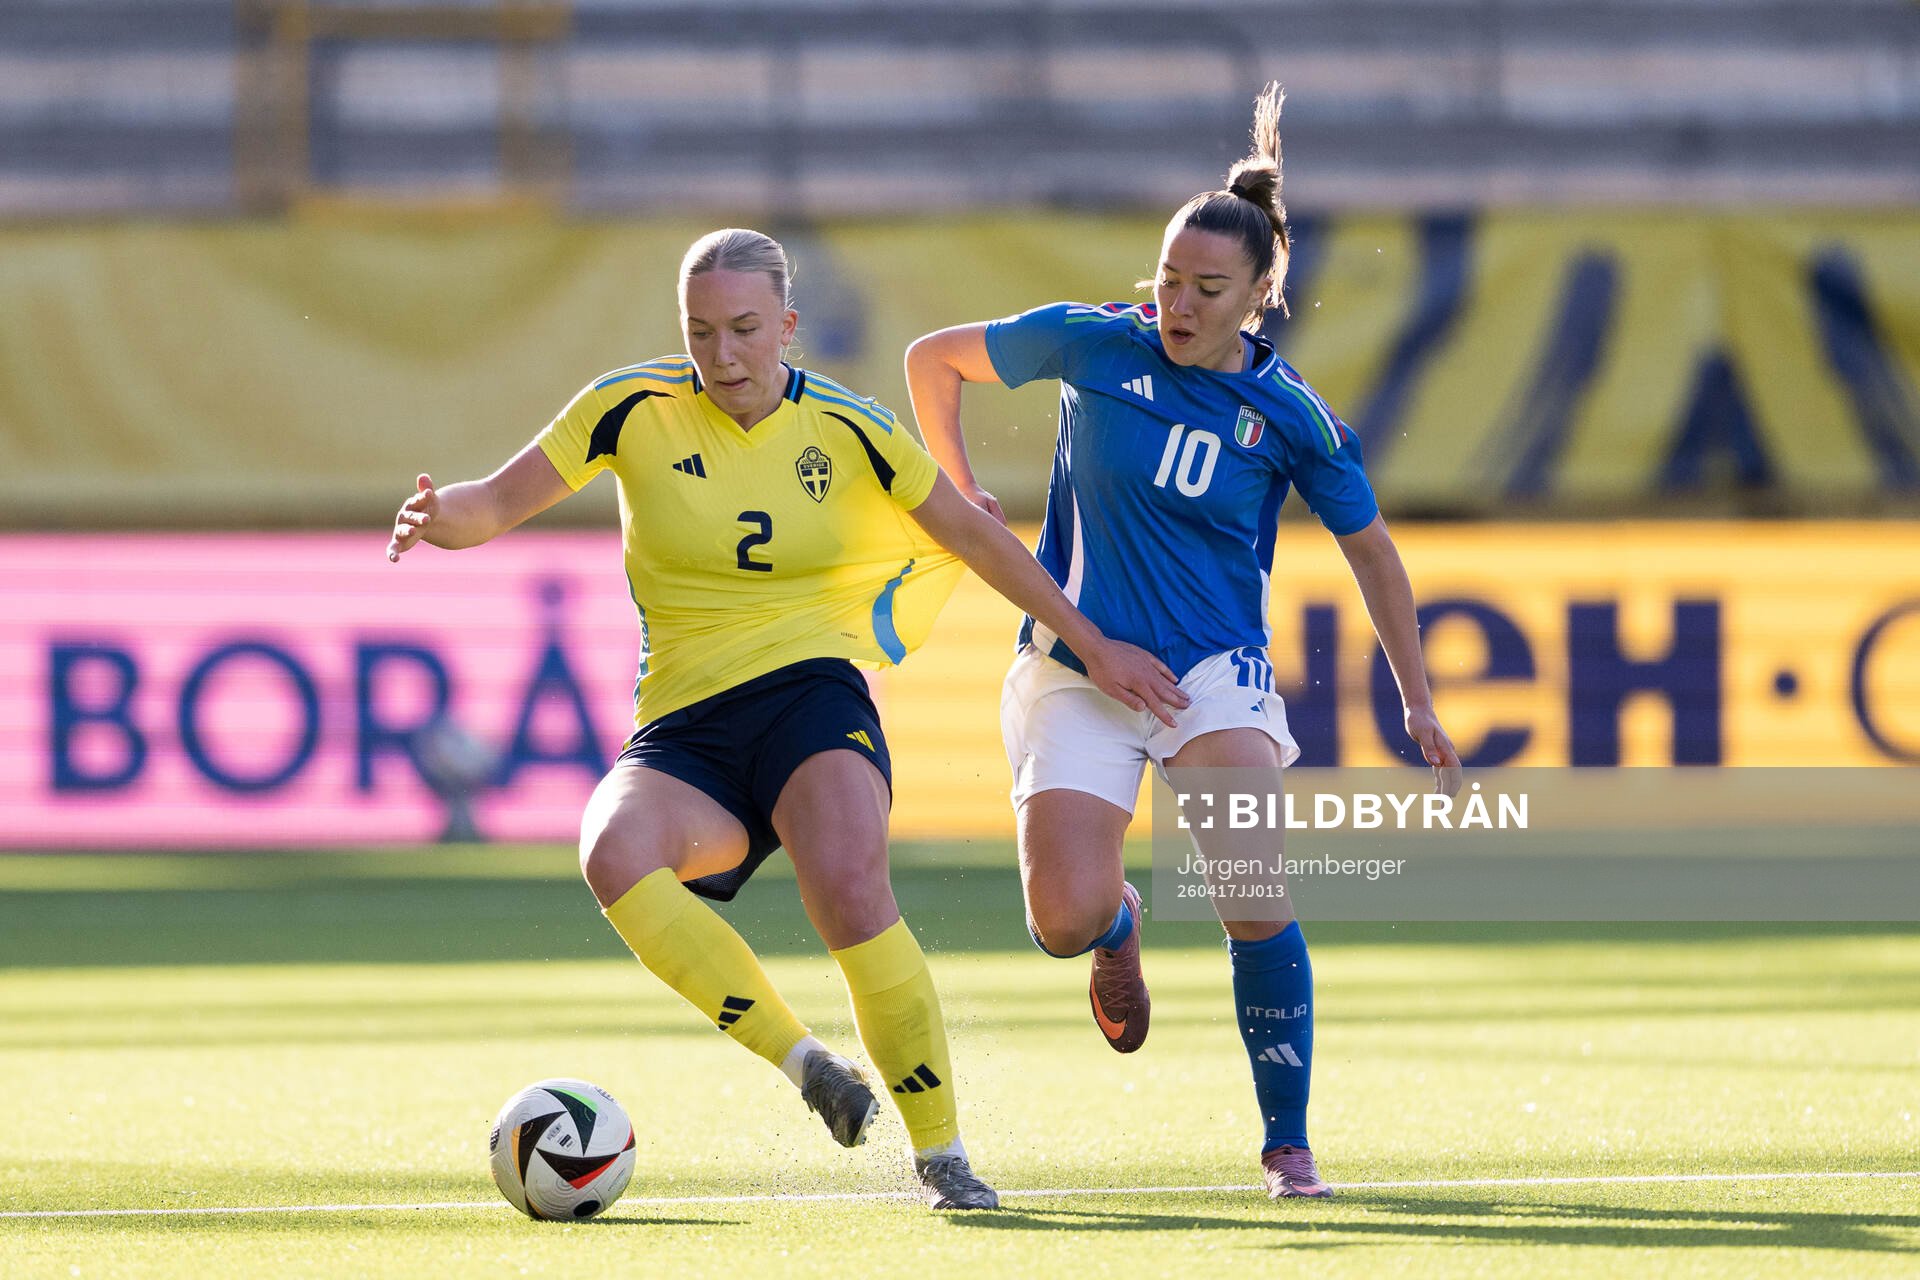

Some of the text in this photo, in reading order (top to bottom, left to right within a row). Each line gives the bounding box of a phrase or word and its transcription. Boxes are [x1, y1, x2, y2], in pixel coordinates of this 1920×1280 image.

[1241, 407, 1264, 422] ITALIA
[1153, 423, 1222, 498] 10
[736, 510, 773, 573] 2
[1246, 1003, 1308, 1019] ITALIA
